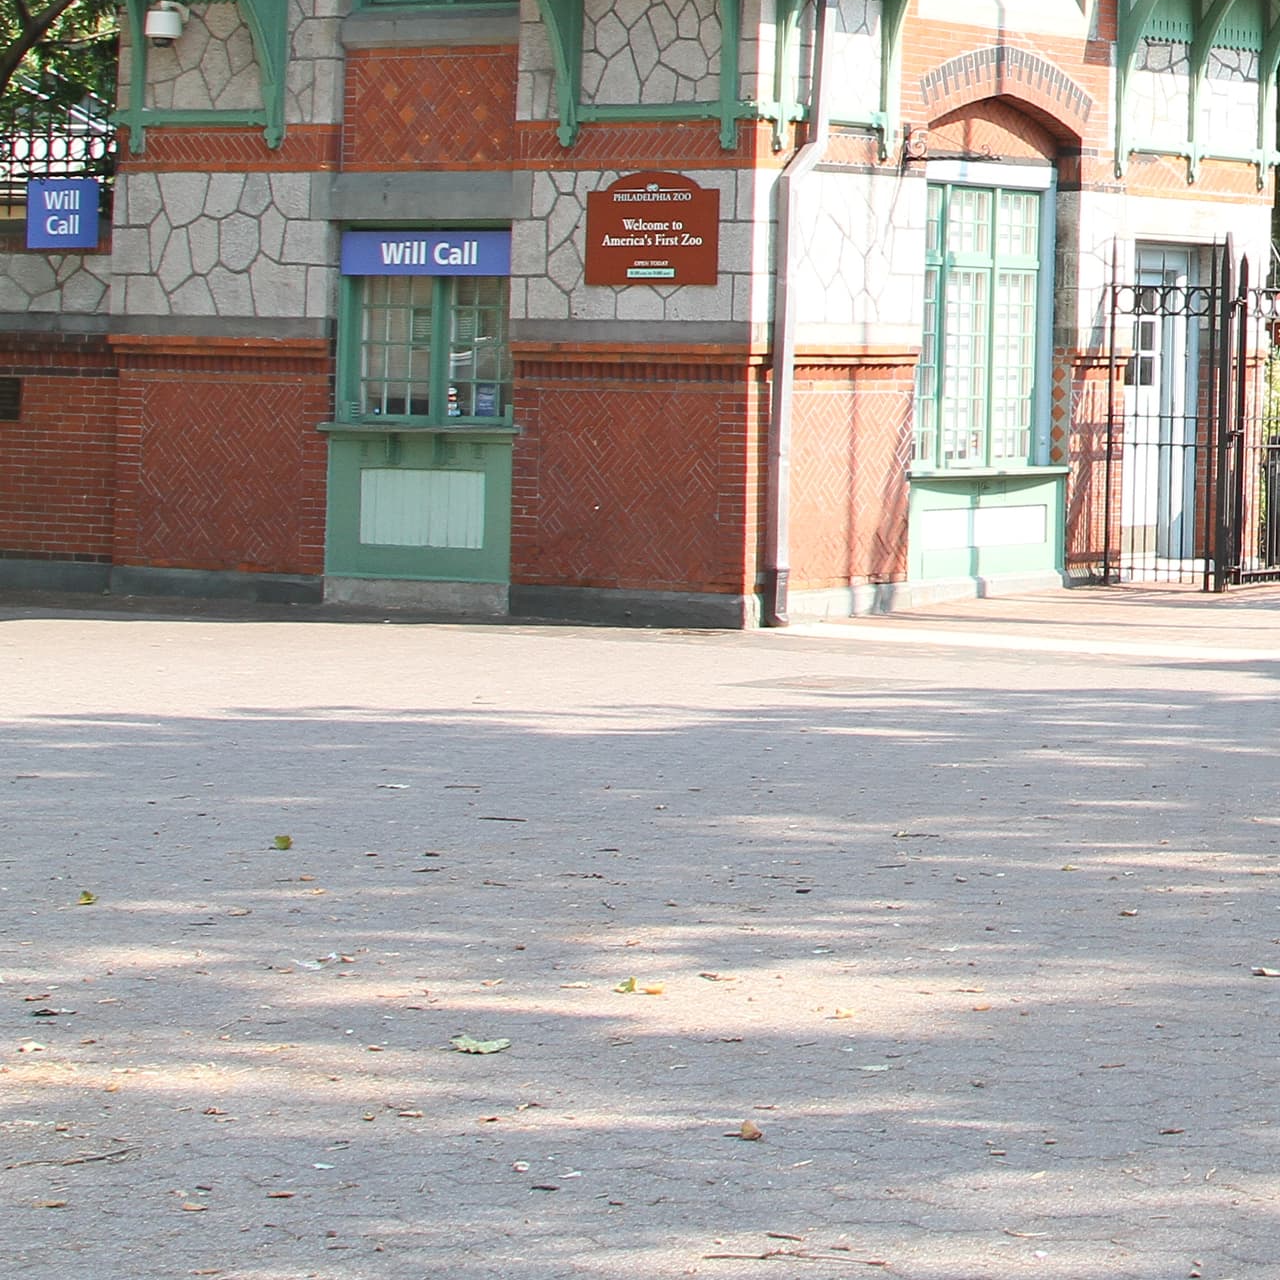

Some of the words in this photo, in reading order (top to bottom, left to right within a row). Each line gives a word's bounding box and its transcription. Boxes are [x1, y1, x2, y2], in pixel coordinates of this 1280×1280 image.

[43, 189, 80, 210] Will
[612, 192, 671, 202] PHILADELPHIA
[672, 192, 692, 201] ZOO
[45, 214, 80, 235] Call
[621, 218, 670, 231] Welcome
[671, 220, 683, 231] to
[601, 233, 653, 247] America's
[654, 232, 679, 246] First
[680, 232, 703, 246] Zoo
[381, 241, 427, 266] Will
[432, 241, 478, 266] Call
